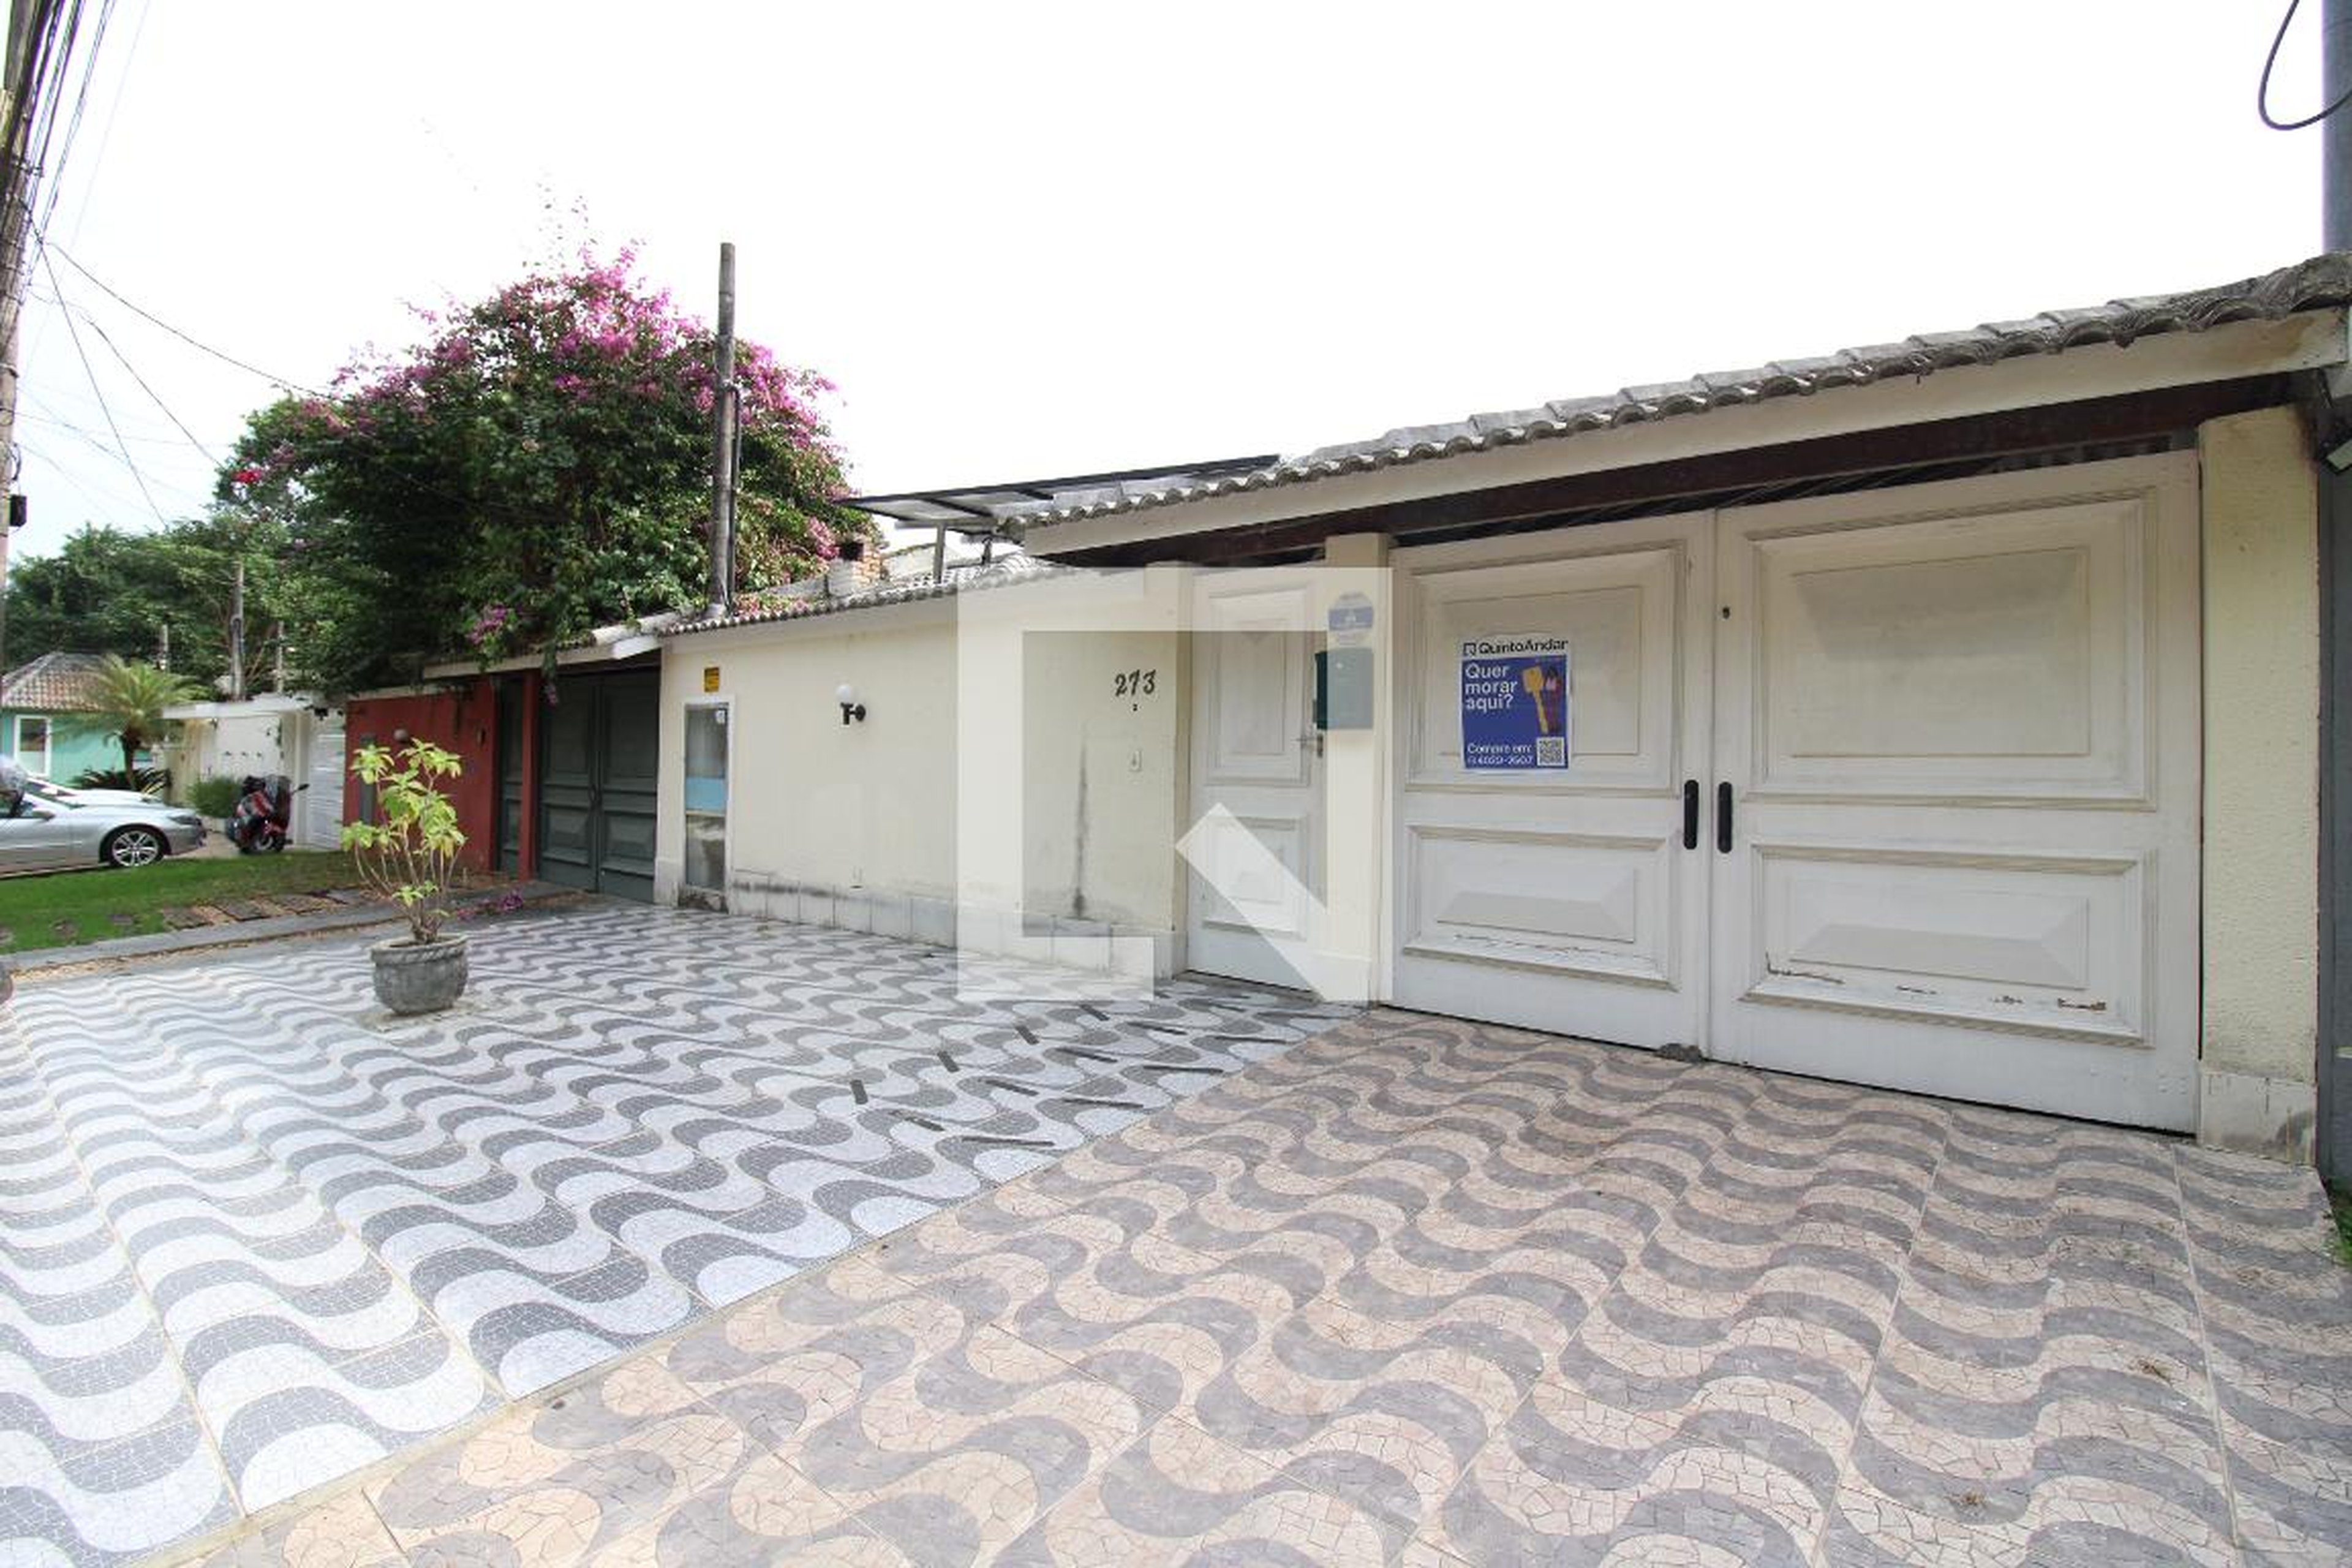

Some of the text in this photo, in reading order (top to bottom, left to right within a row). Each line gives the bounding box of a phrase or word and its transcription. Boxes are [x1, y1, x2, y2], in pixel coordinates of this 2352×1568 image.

[1479, 639, 1567, 654] QuintoAndar
[1466, 663, 1509, 679] Quer
[1115, 669, 1156, 697] 273
[1465, 681, 1518, 695] morar
[1465, 694, 1513, 712] aqui?
